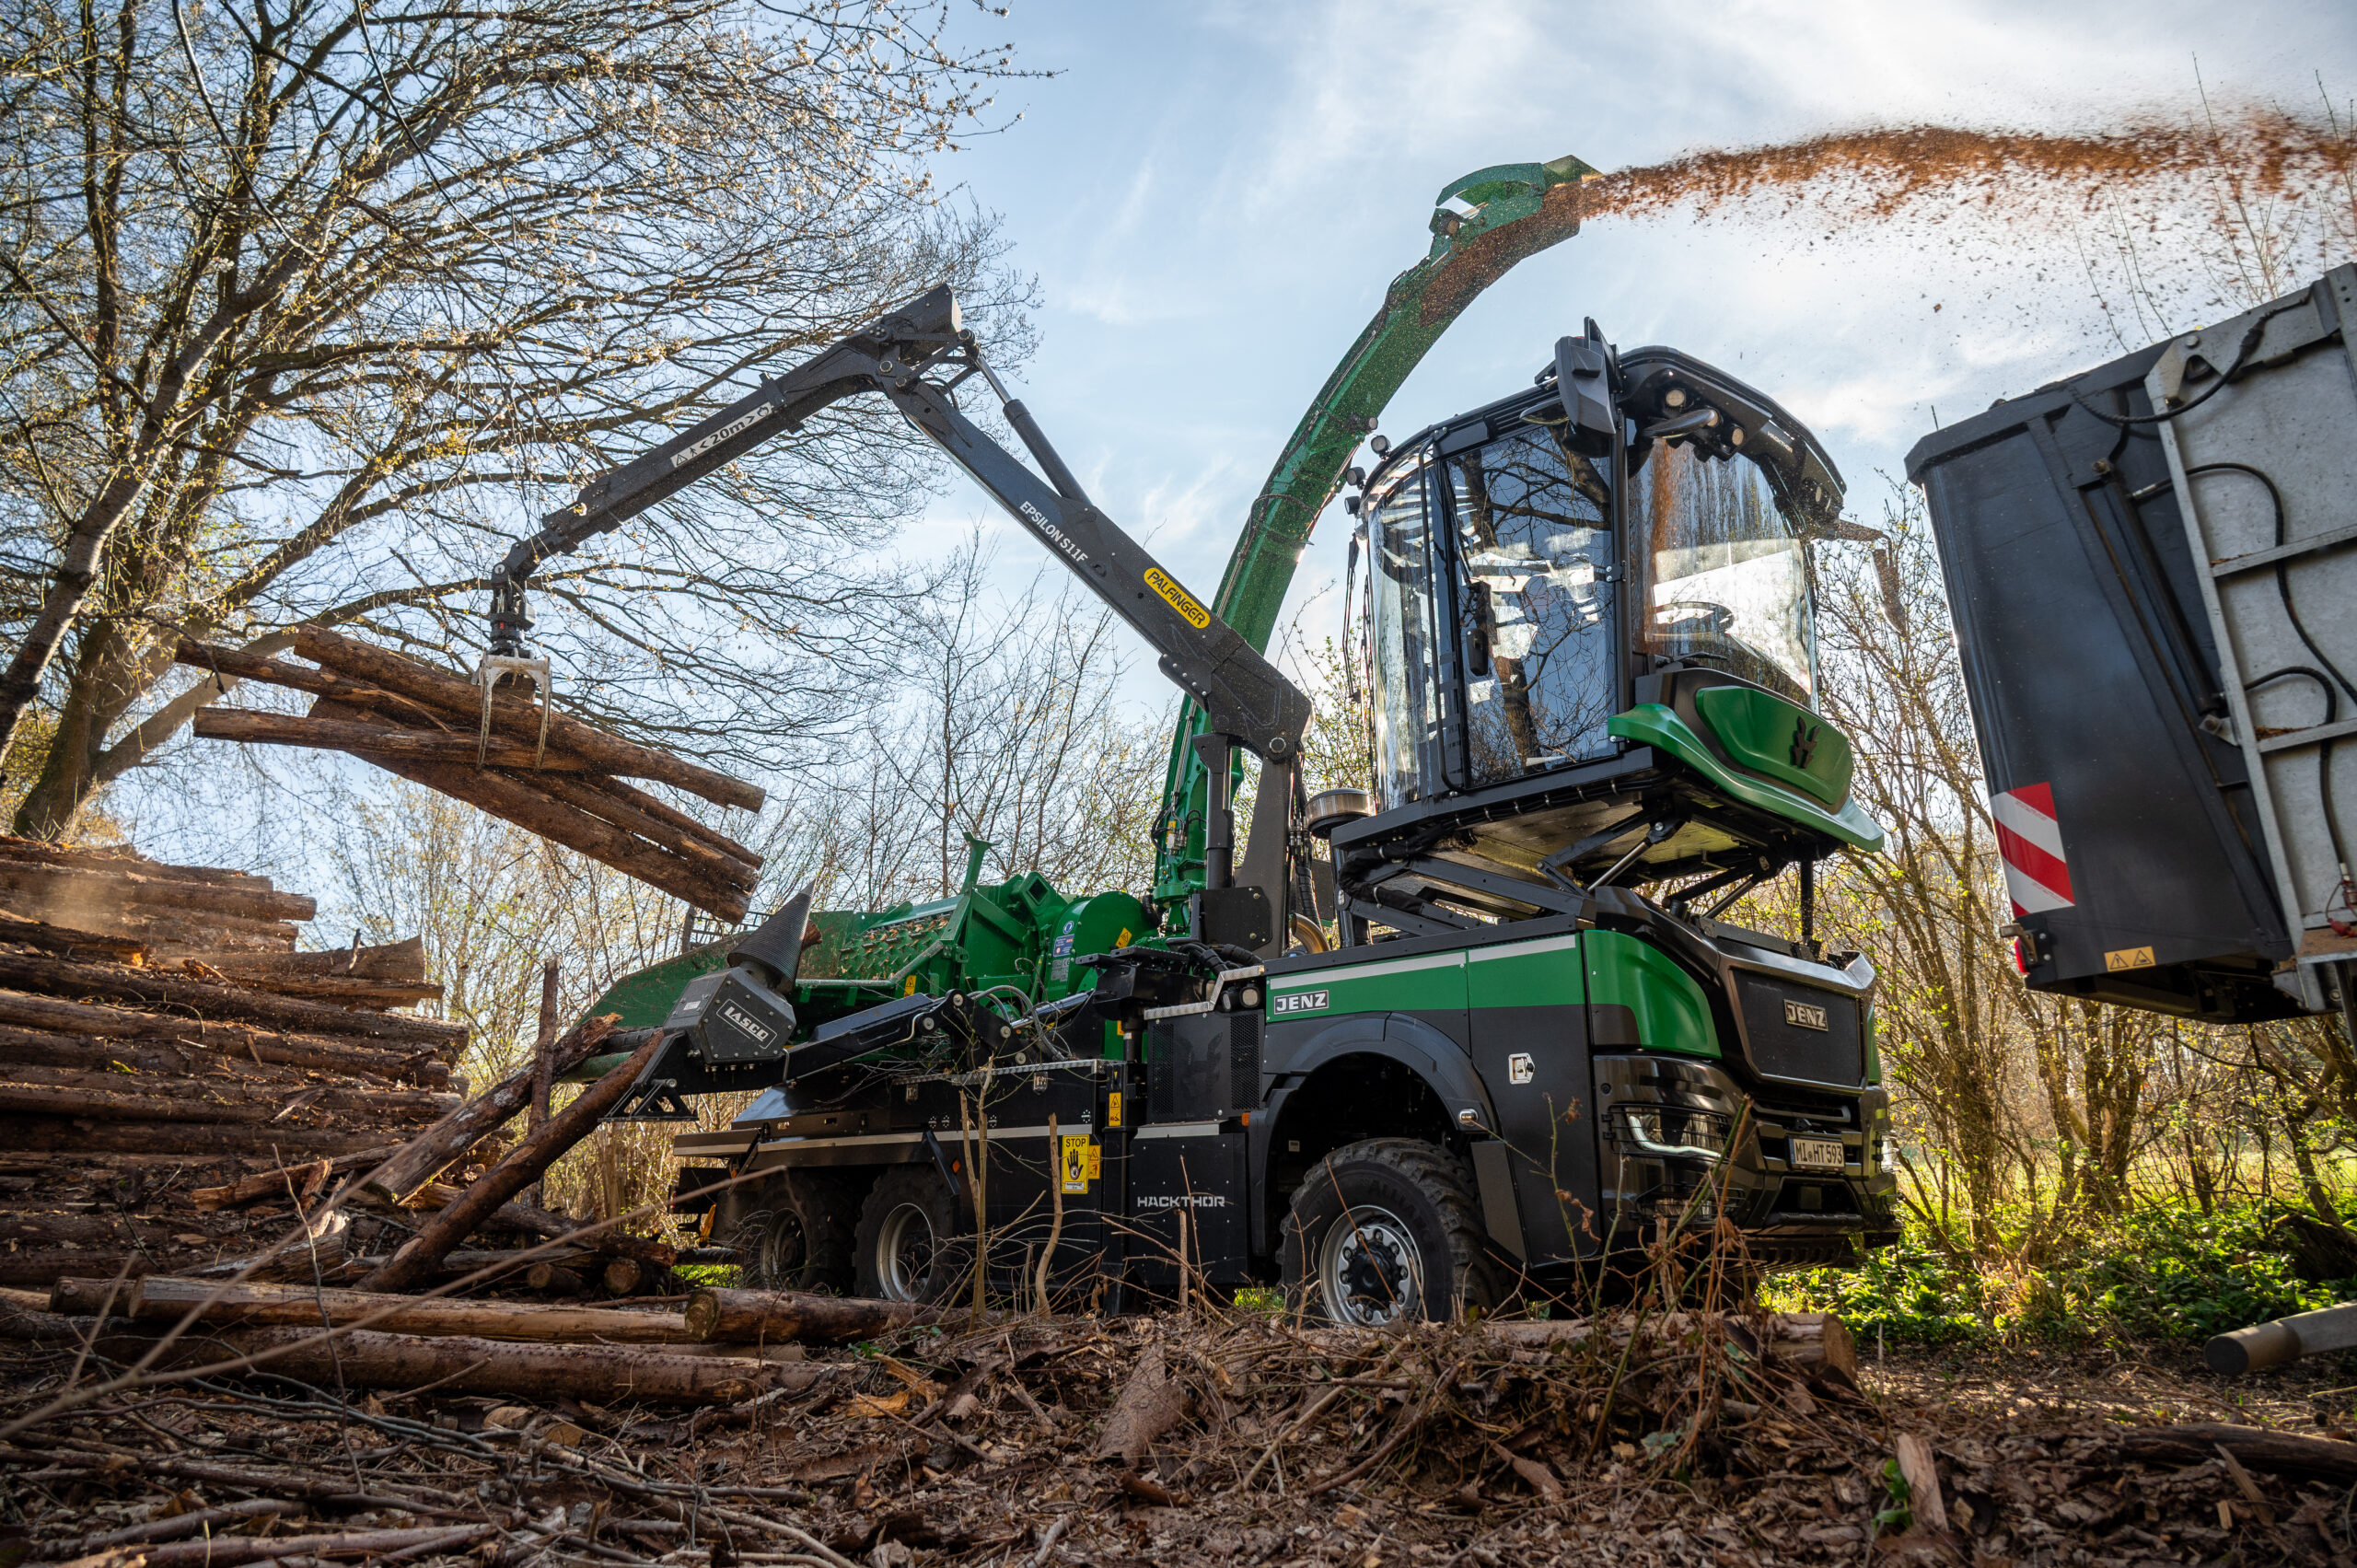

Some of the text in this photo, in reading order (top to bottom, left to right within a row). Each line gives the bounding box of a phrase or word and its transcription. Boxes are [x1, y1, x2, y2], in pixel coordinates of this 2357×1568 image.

[1019, 500, 1089, 562] EPSILON S11F
[1147, 571, 1206, 625] PALFINGER
[1276, 993, 1326, 1012] JENZ
[724, 1005, 770, 1042] LASCO
[1786, 1004, 1826, 1028] JENZ
[1065, 1138, 1086, 1147] STOP
[1795, 1142, 1843, 1164] MI HT 593
[1137, 1196, 1225, 1207] HACKTHOR
